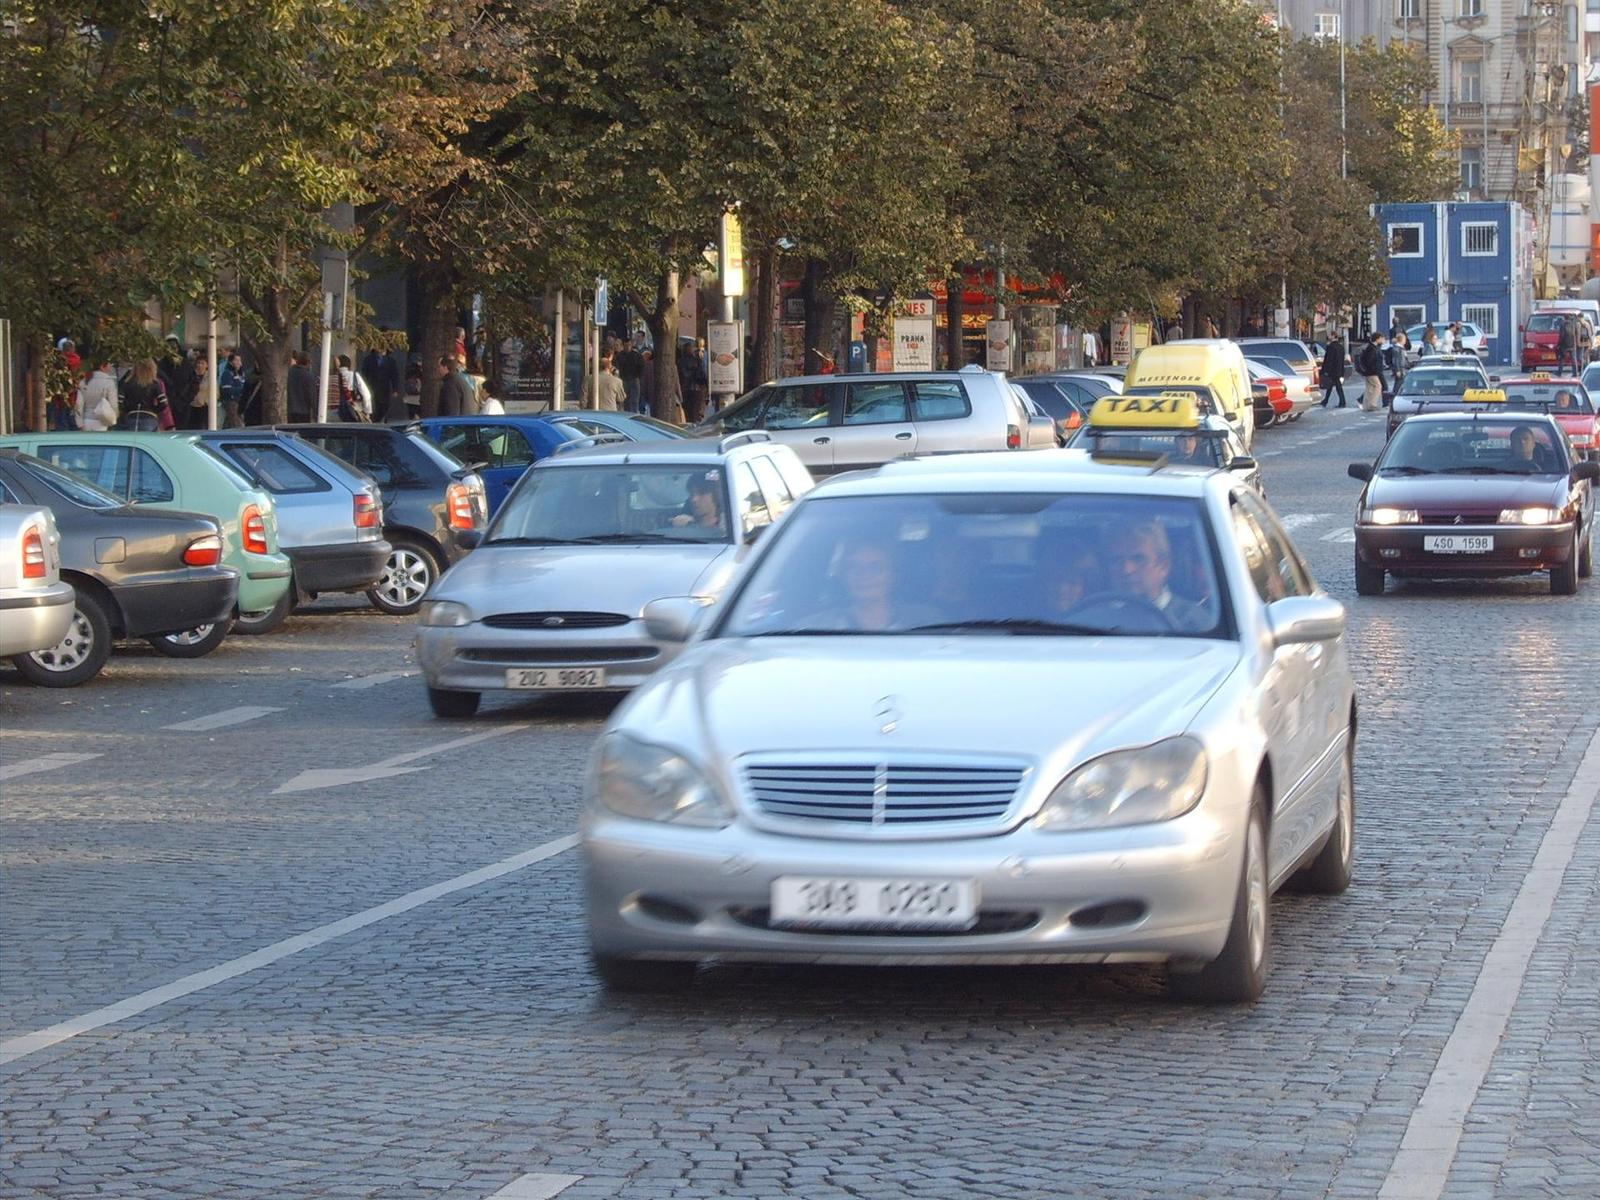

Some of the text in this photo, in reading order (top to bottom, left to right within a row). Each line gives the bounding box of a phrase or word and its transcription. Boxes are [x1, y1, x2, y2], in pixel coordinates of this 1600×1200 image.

[852, 346, 861, 358] P
[1138, 374, 1202, 383] MESSENGER
[1105, 398, 1181, 413] TAXI
[1462, 537, 1488, 549] 1598
[518, 669, 598, 687] 2U2 9082
